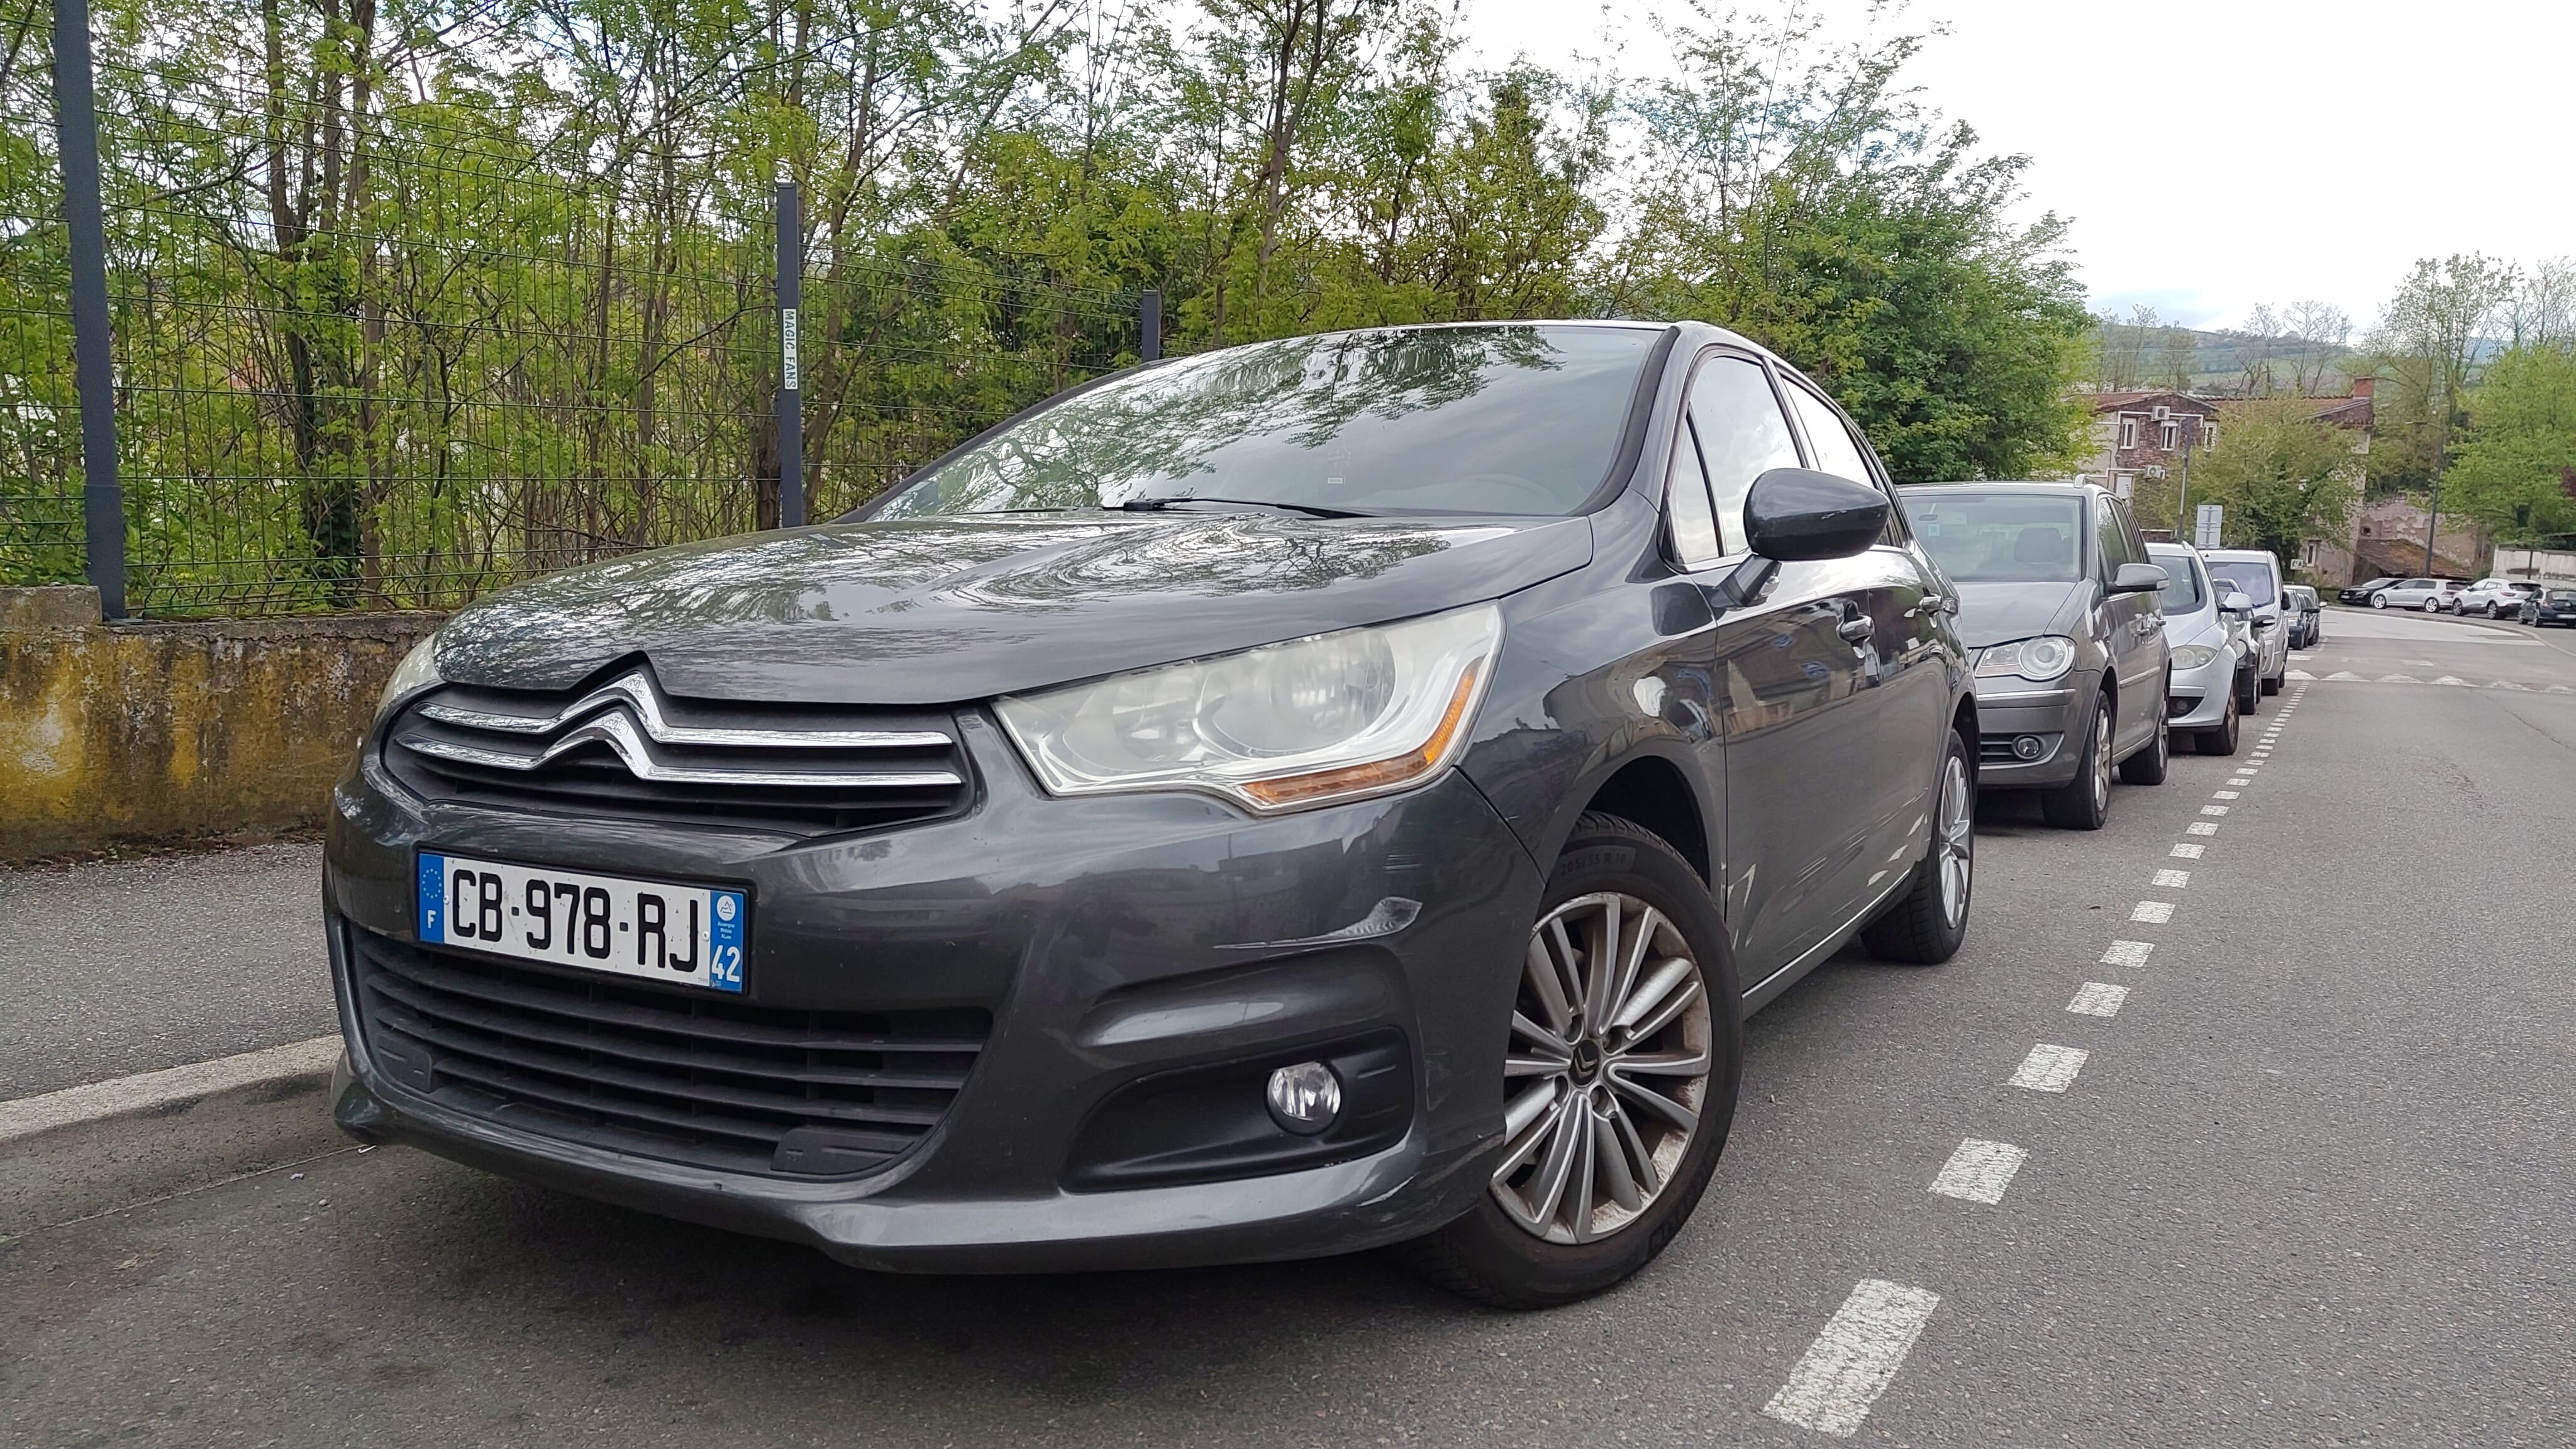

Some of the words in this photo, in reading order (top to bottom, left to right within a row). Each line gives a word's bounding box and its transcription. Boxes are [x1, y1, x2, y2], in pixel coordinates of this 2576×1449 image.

[784, 311, 795, 350] MAGIC
[786, 357, 796, 387] FANS
[1560, 853, 1601, 876] 205/55
[1605, 852, 1611, 863] R
[1616, 853, 1626, 865] 16
[427, 909, 436, 929] F
[711, 945, 740, 982] 42
